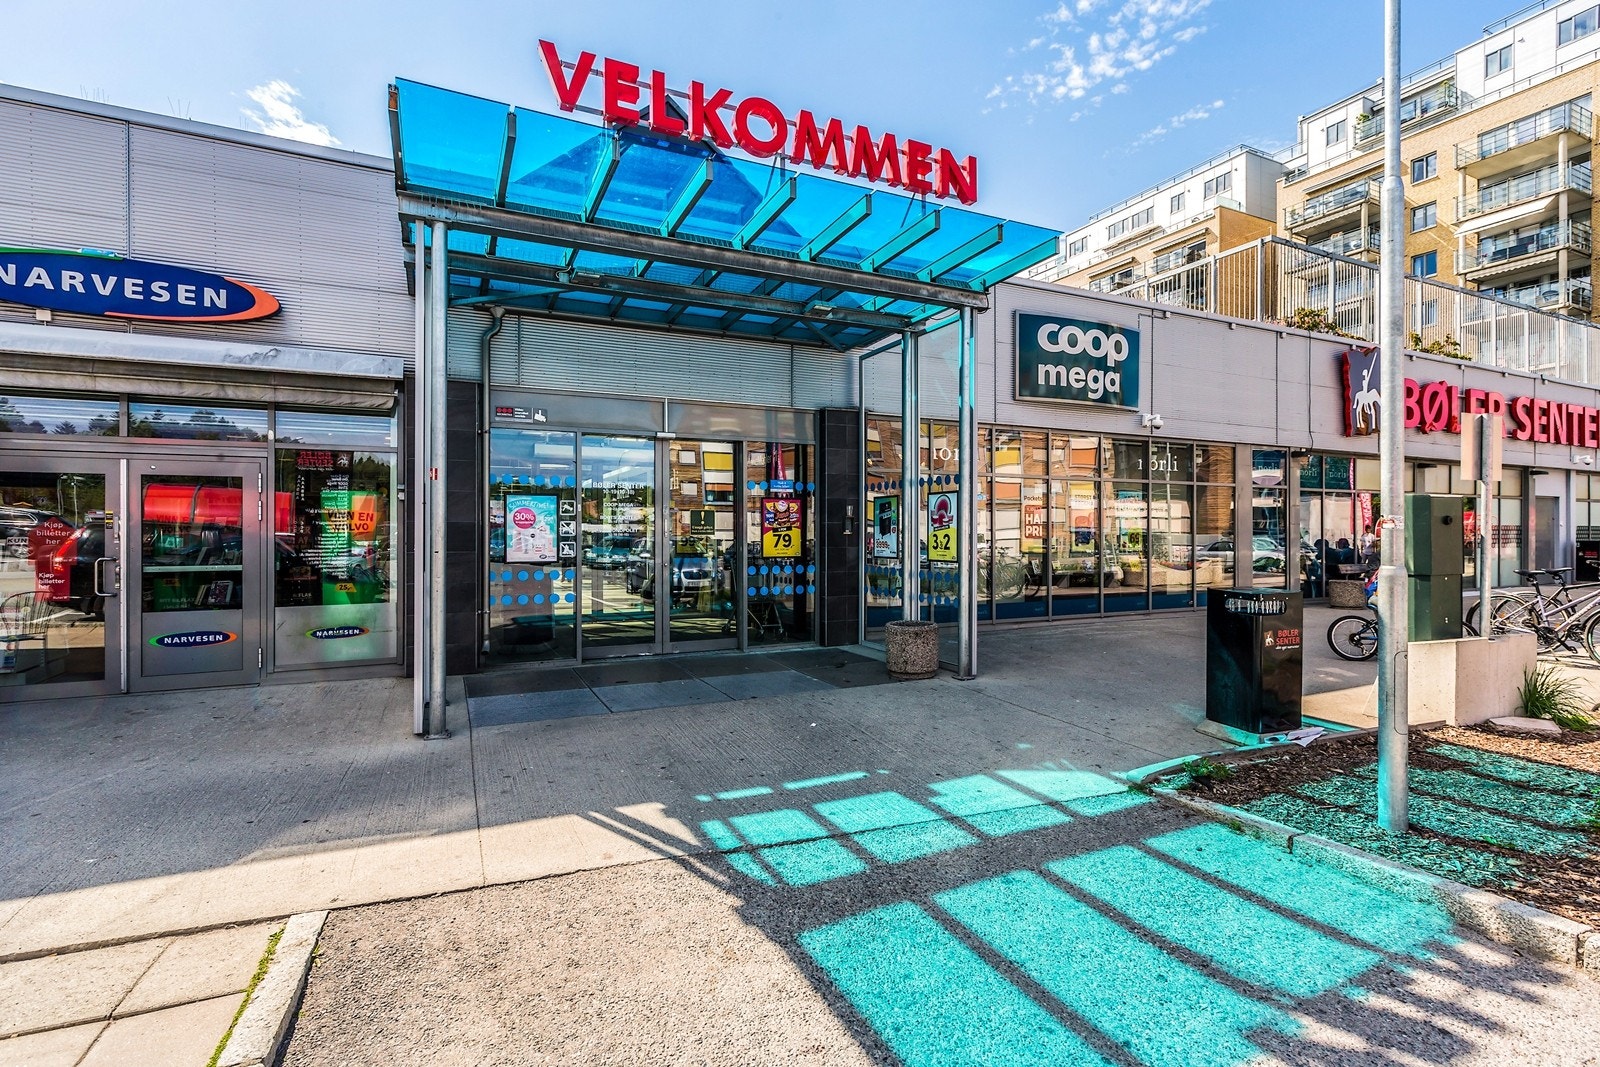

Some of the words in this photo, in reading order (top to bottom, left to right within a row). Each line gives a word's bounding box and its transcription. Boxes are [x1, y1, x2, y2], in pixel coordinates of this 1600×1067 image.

[538, 38, 978, 206] VELKOMMEN
[0, 262, 228, 310] NARVESEN
[1037, 323, 1130, 367] coop
[1037, 363, 1121, 400] mega
[1510, 395, 1600, 449] SENTE
[358, 512, 374, 522] EN
[514, 512, 535, 521] 30%
[44, 521, 64, 530] Kjøp
[36, 529, 71, 537] billetter
[932, 533, 939, 551] 3
[943, 533, 951, 551] 2
[38, 572, 55, 580] Kjøp
[164, 633, 224, 645] NARVESEN
[1277, 629, 1300, 638] BØLER
[1275, 636, 1301, 645] SENTER
